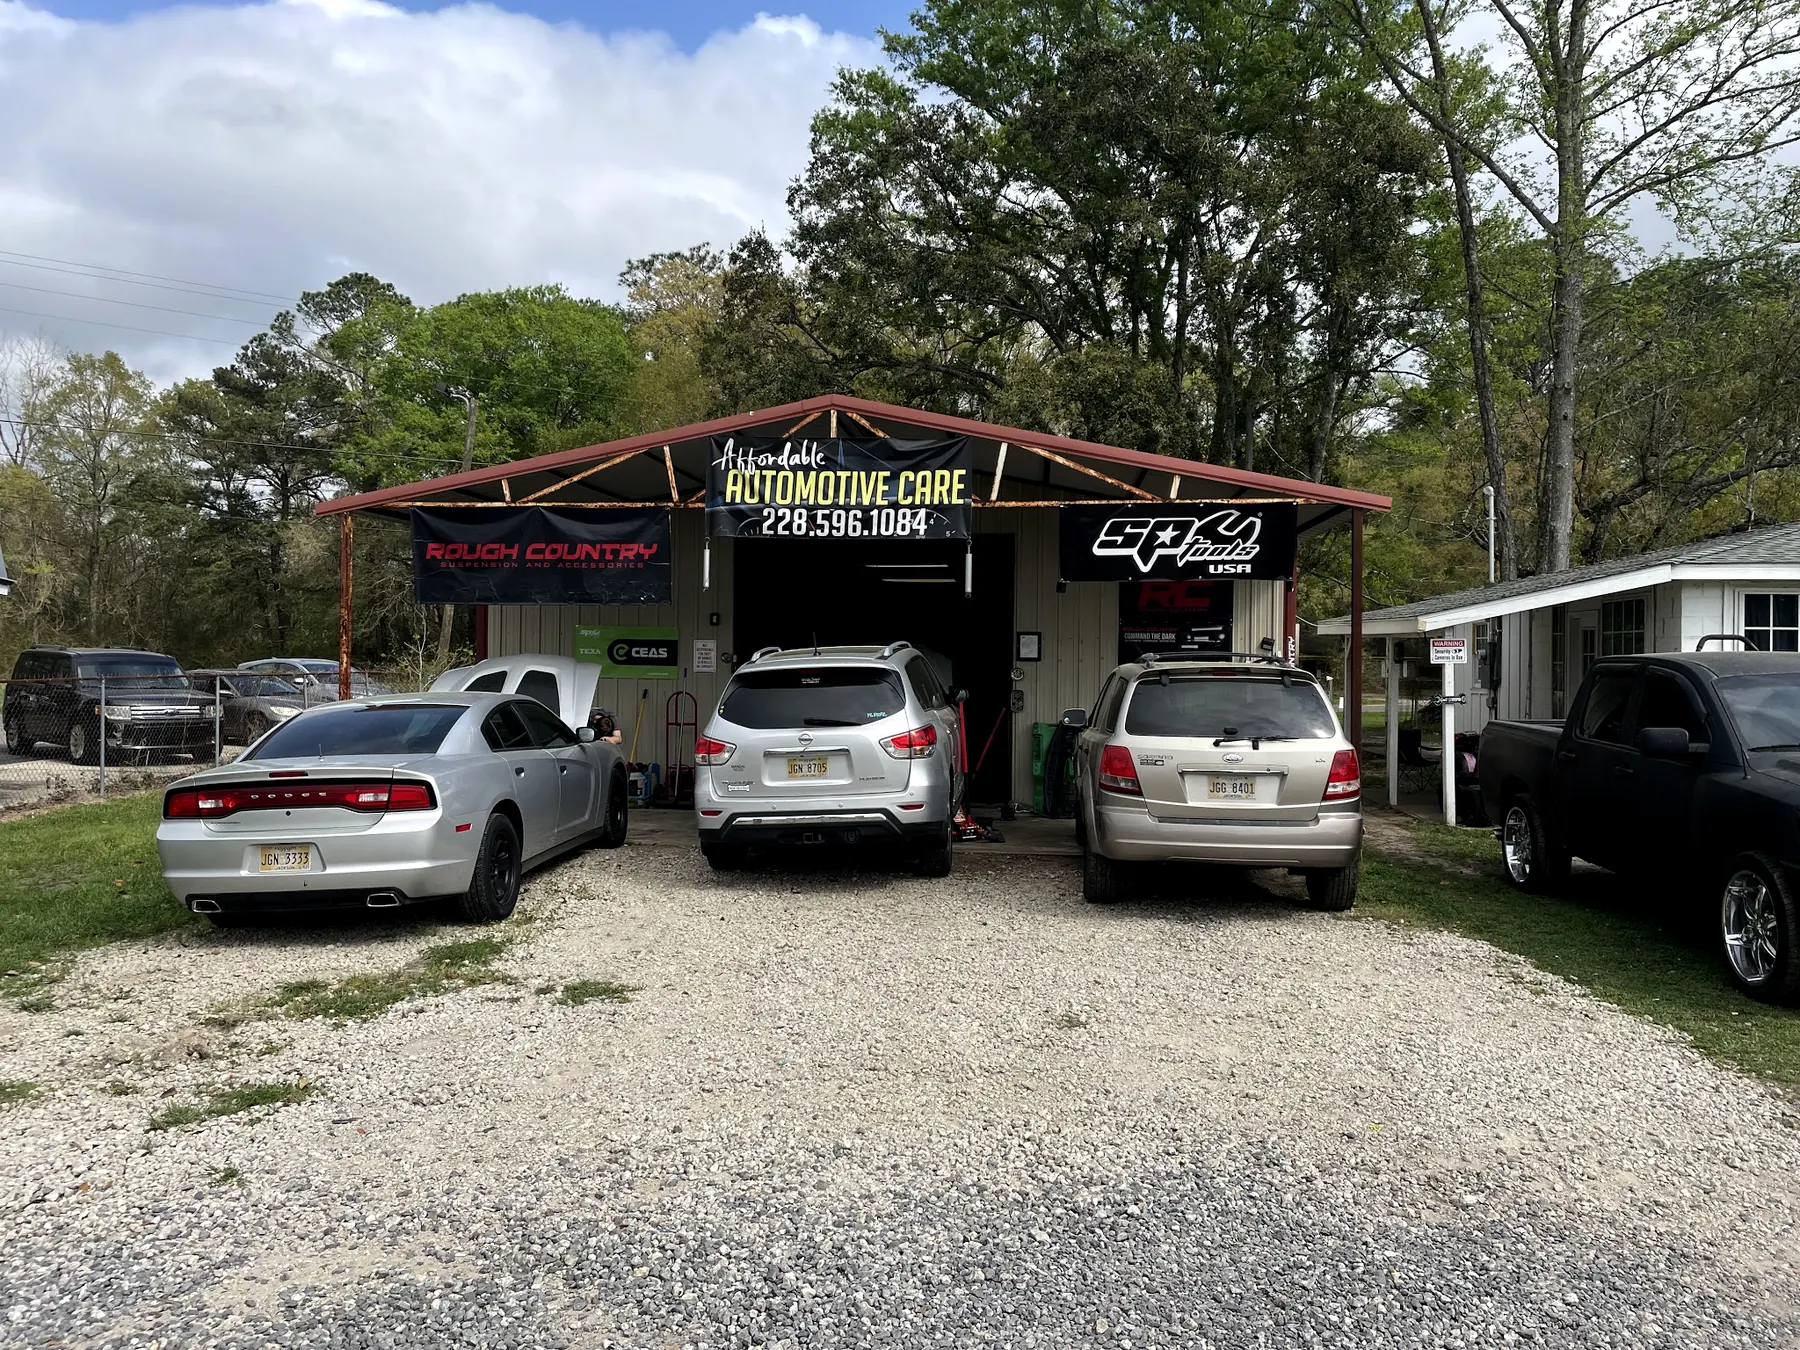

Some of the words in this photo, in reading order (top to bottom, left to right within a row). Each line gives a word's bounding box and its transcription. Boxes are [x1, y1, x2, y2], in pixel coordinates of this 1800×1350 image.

[711, 437, 826, 474] Affordable
[725, 470, 891, 505] AUTOMOTIVE
[898, 469, 967, 505] CARE
[762, 508, 928, 537] 228.596.1084
[425, 542, 520, 560] ROUGH
[525, 542, 659, 561] COUNTRY
[1177, 537, 1260, 568] tools
[1208, 563, 1252, 574] USA
[1123, 632, 1151, 640] COMMAND
[1151, 632, 1161, 640] THE
[1161, 632, 1177, 640] DARK
[631, 647, 668, 658] CEAS
[788, 763, 804, 774] JGN
[807, 762, 827, 773] 8705
[1210, 782, 1227, 793] JGG
[1232, 782, 1255, 794] 8401
[261, 853, 279, 866] JGN
[285, 852, 309, 865] 3333
